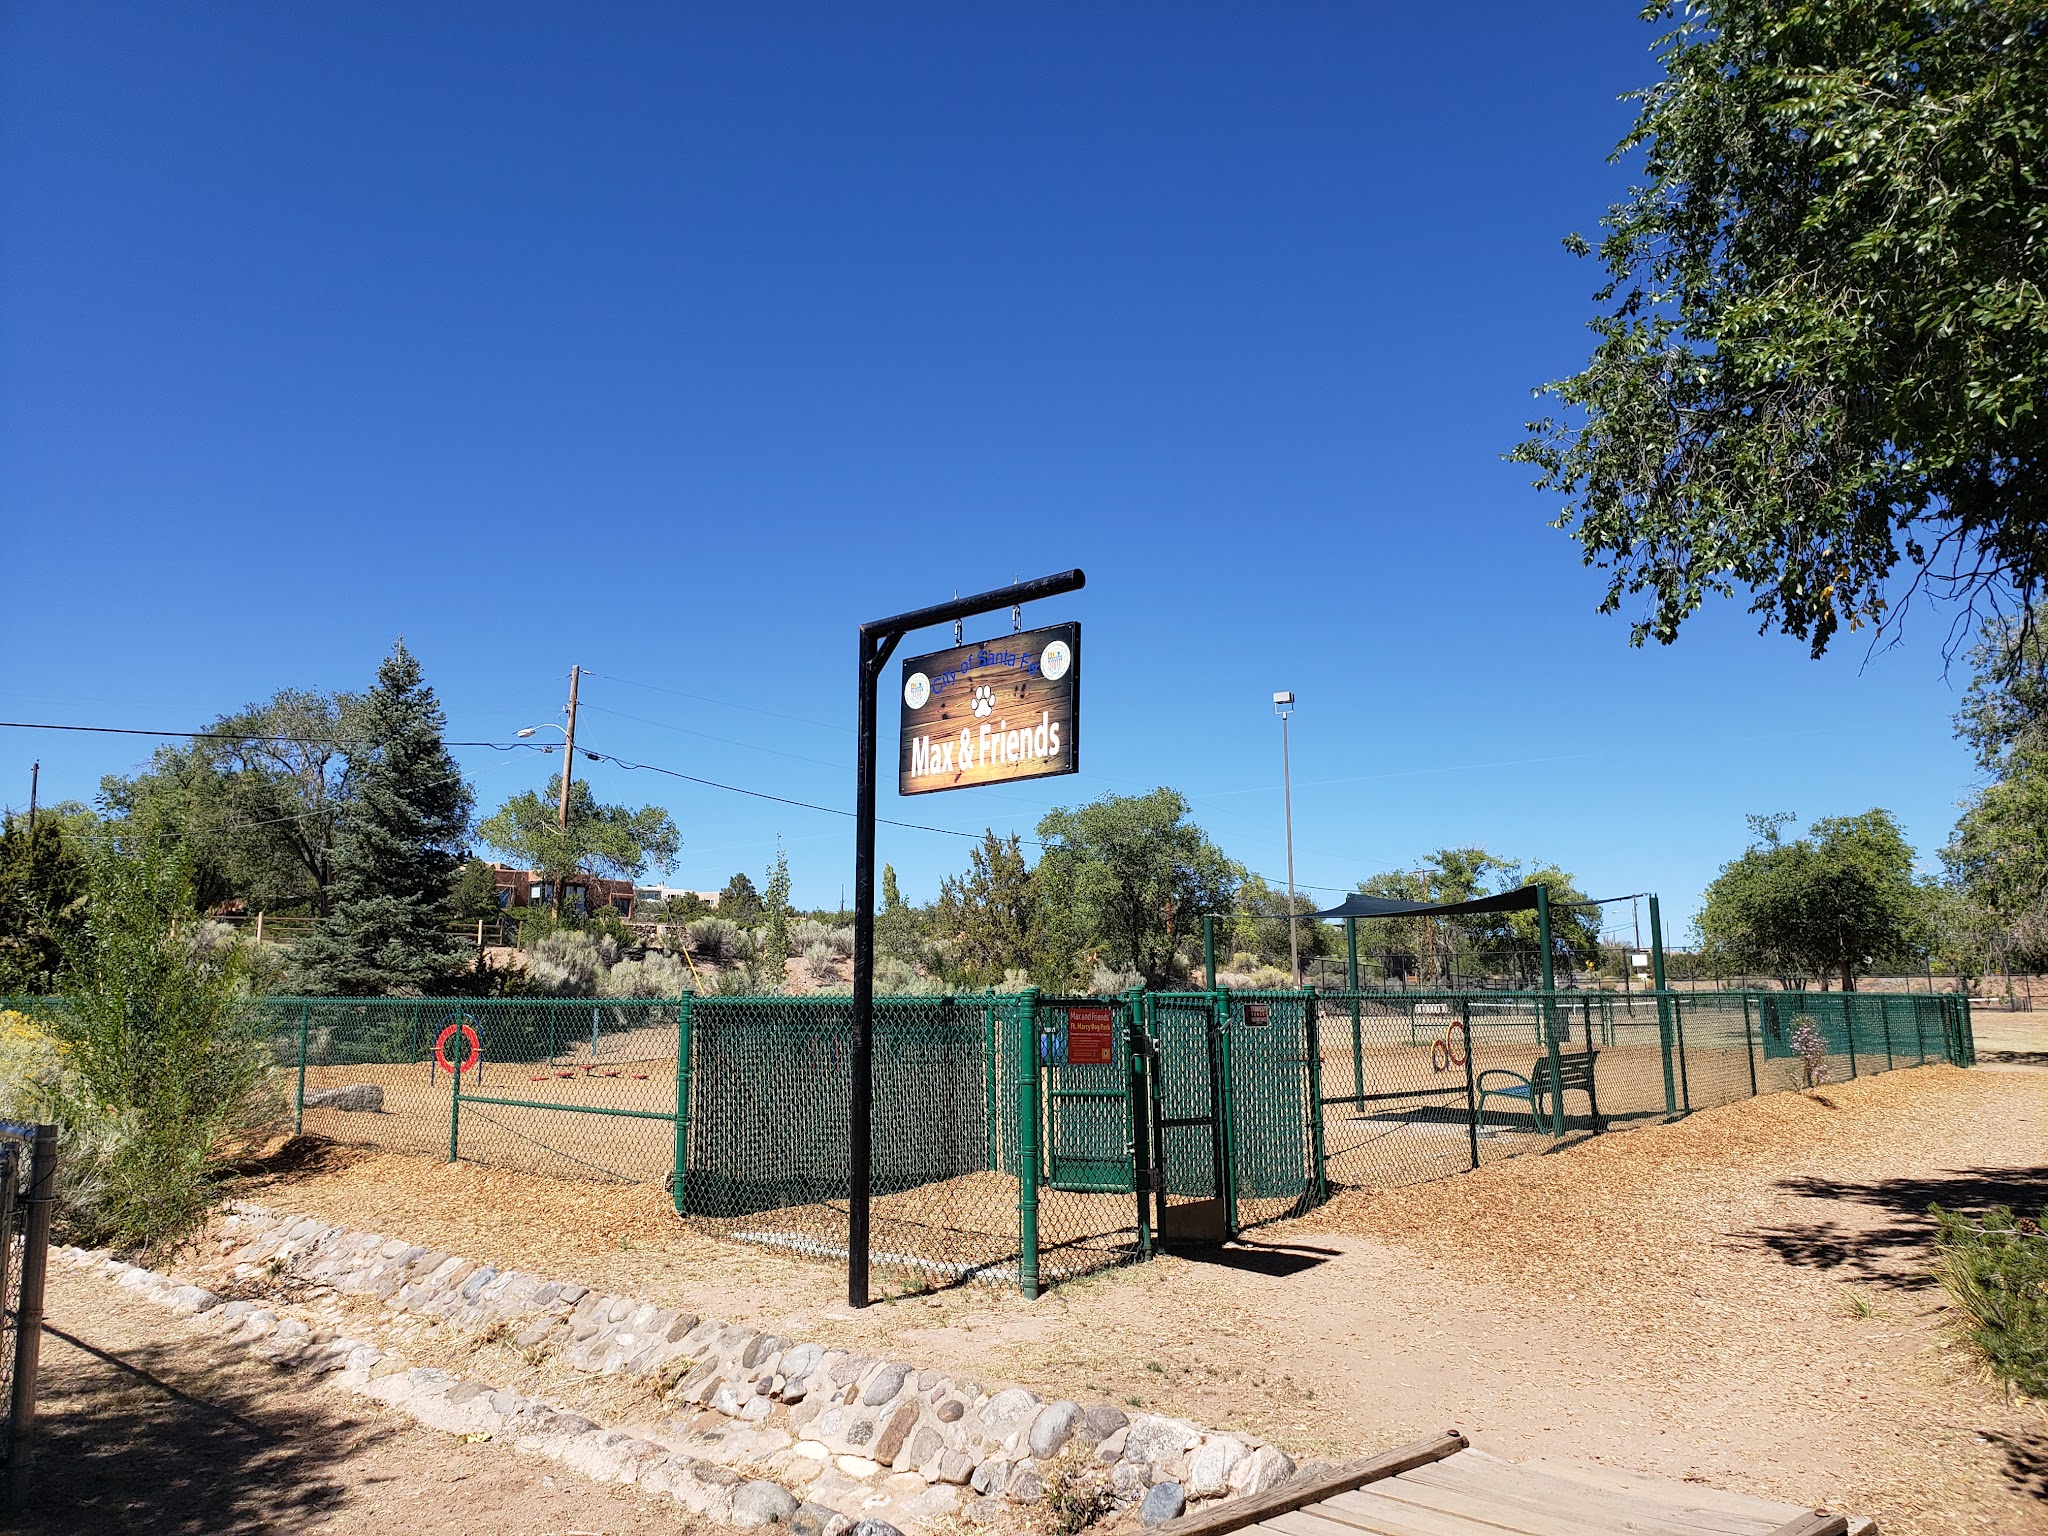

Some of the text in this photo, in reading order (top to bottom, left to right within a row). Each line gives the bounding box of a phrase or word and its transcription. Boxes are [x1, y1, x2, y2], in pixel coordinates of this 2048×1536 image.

[932, 668, 957, 695] City
[961, 654, 973, 674] of
[977, 649, 1016, 668] Santa
[1020, 652, 1038, 676] Fe
[911, 711, 1060, 778] Max & Friends
[1070, 1011, 1081, 1020] Max
[1082, 1013, 1091, 1021] and
[1091, 1023, 1100, 1032] Dog
[1100, 1023, 1111, 1031] Park
